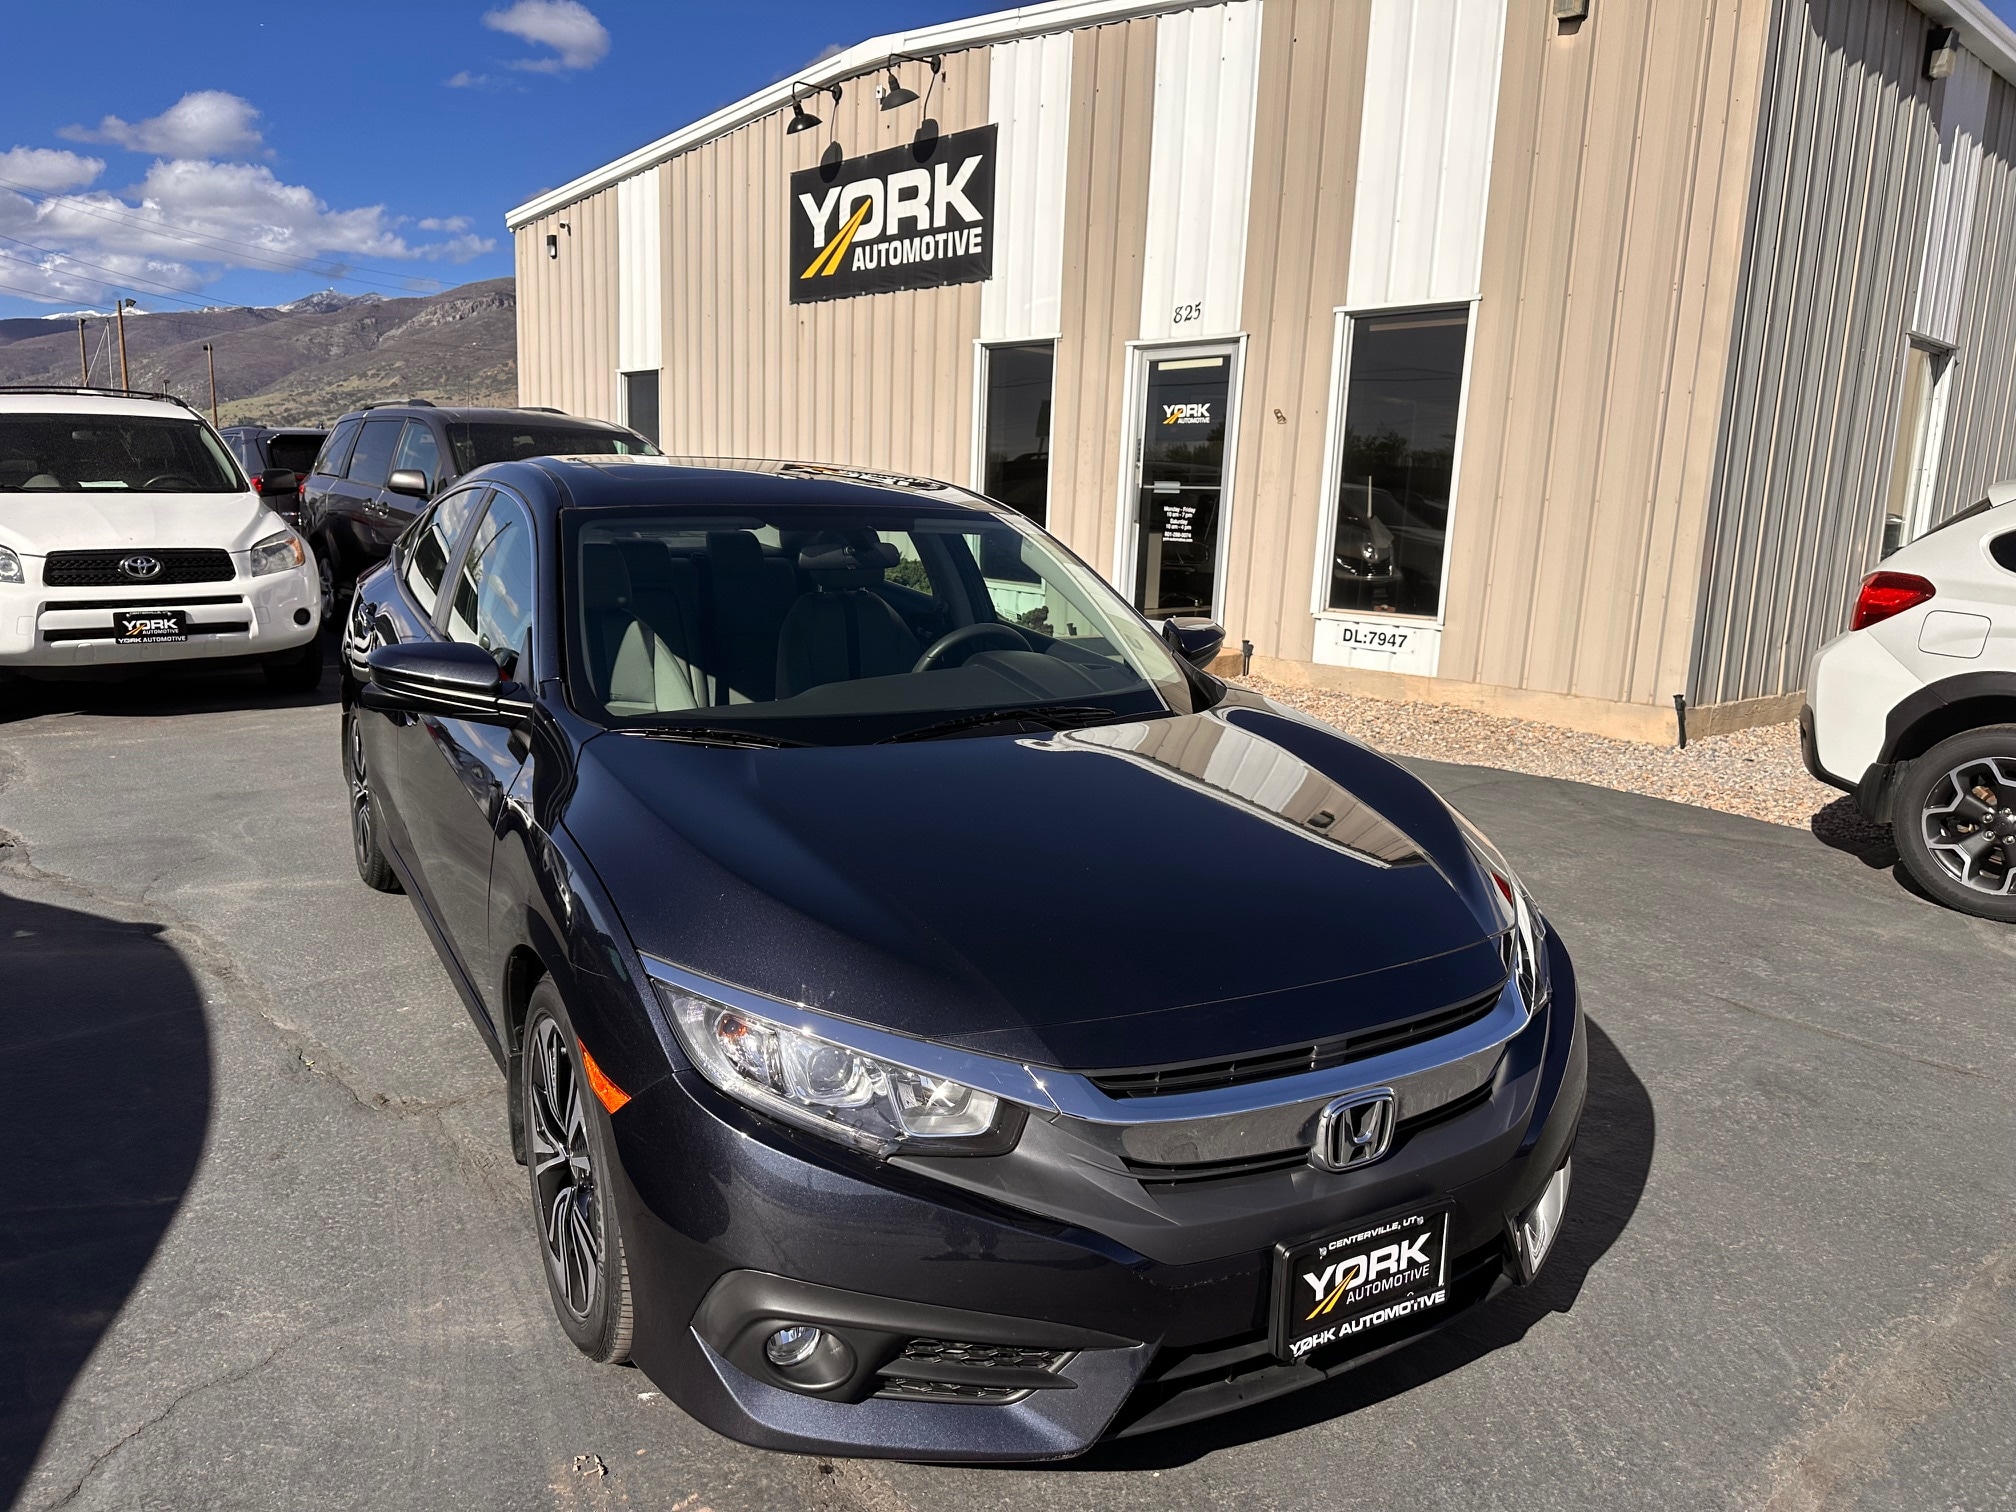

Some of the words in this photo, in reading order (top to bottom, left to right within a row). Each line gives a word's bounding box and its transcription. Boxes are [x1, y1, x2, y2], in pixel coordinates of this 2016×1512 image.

[798, 154, 984, 249] YORK
[852, 226, 983, 272] AUTOMOTIVE
[1173, 301, 1202, 324] 825
[1162, 403, 1211, 418] YORK
[122, 618, 178, 631] YORK
[143, 635, 186, 643] AUTOMOTIVE
[1342, 628, 1408, 648] DL:7947
[1328, 1221, 1402, 1251] CENTERVILLE,
[1402, 1216, 1417, 1227] UT
[1303, 1232, 1432, 1302] YORK
[1345, 1263, 1430, 1305] AUTOMOTIVE
[1338, 1289, 1446, 1337] AUTOMOTIVE
